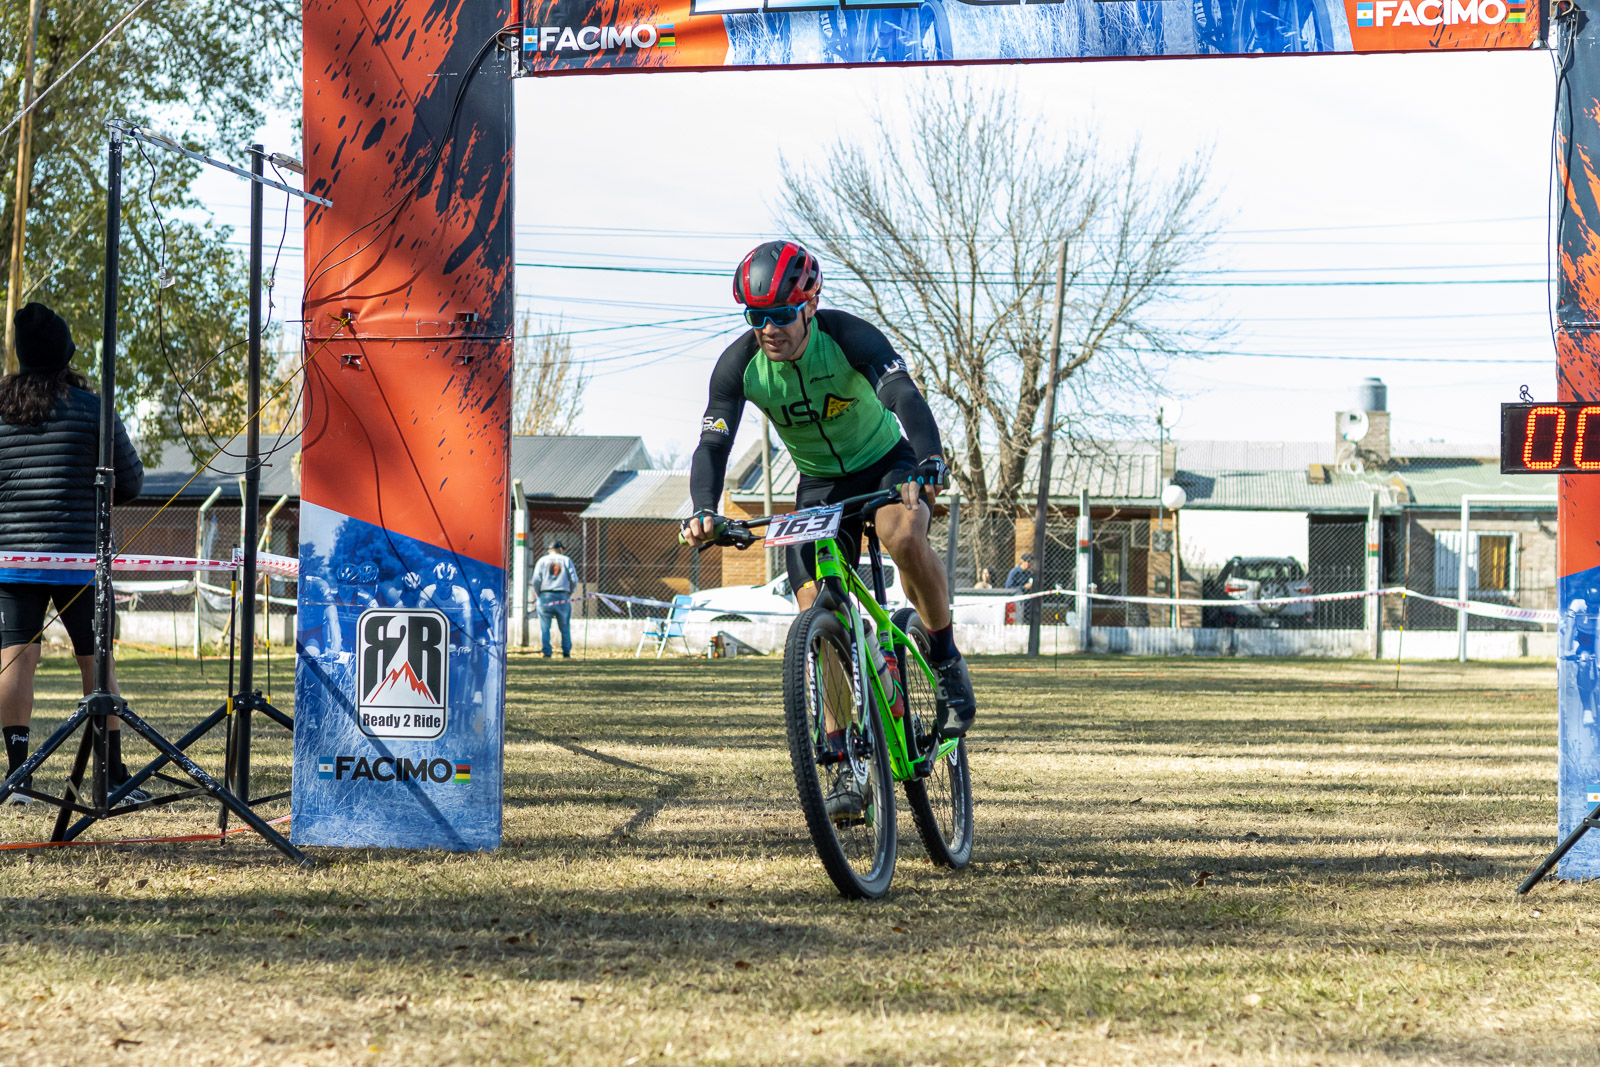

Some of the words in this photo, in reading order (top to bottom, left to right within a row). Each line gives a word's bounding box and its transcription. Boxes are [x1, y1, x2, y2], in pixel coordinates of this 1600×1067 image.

[1375, 0, 1507, 27] FACIMO
[540, 24, 657, 51] FACIMO
[774, 513, 834, 538] 163
[363, 713, 400, 728] Ready
[403, 714, 411, 727] 2
[414, 714, 441, 728] Ride
[336, 756, 453, 783] FACIMO
